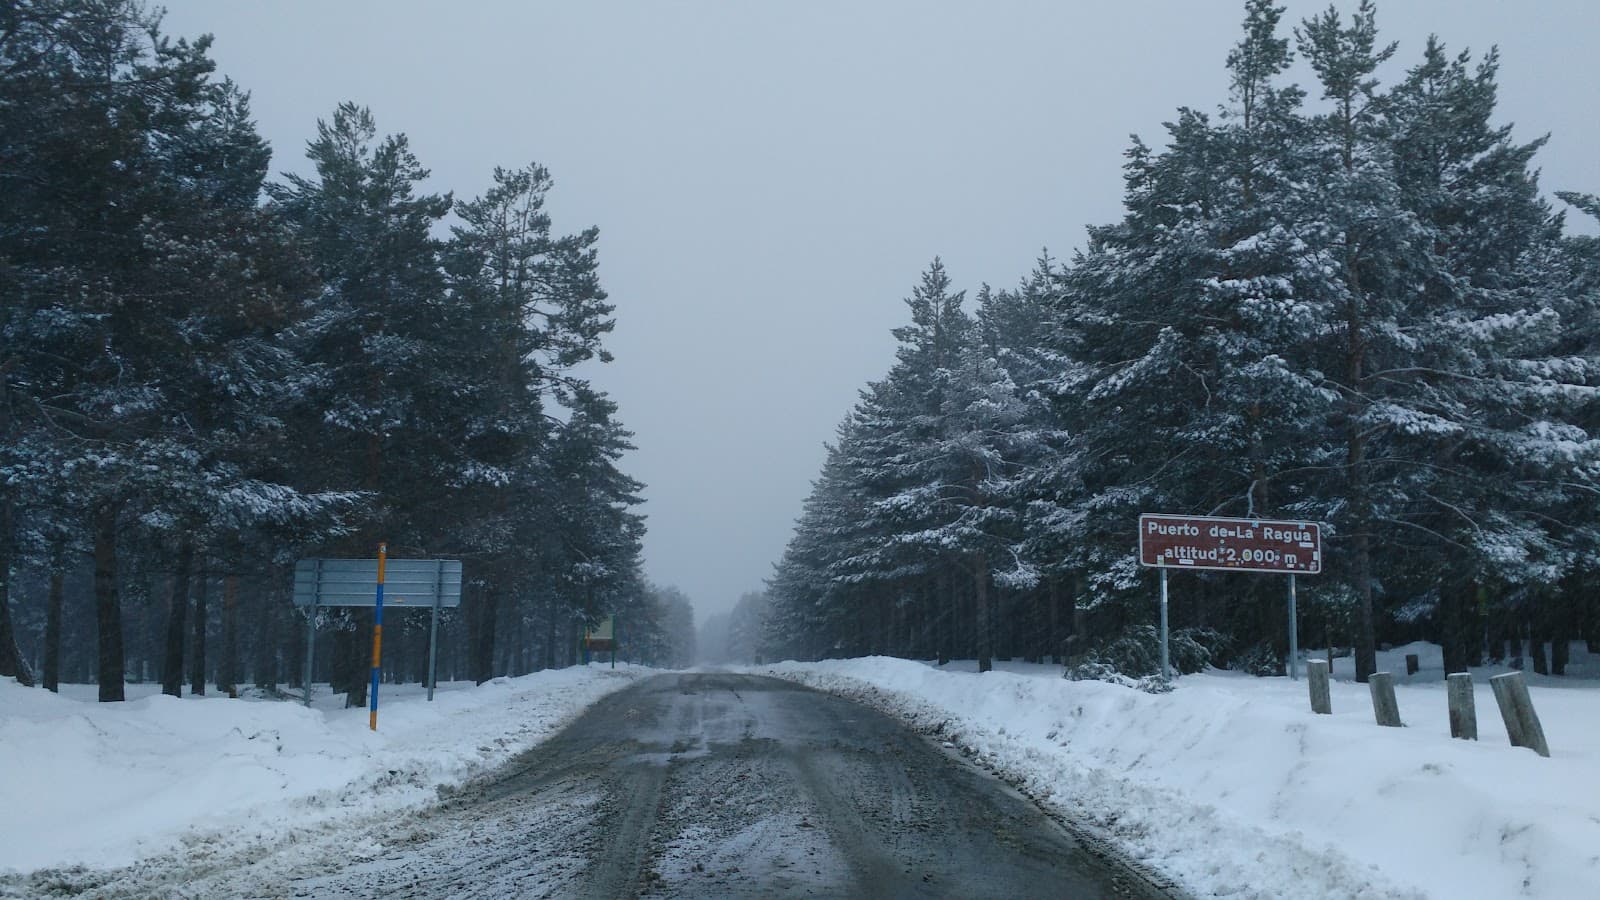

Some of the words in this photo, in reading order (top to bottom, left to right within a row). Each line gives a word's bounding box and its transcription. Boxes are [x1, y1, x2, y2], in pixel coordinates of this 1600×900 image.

[1148, 521, 1200, 536] Puerto
[1236, 526, 1254, 539] La
[1263, 527, 1312, 543] Ragua
[1164, 545, 1218, 561] altitud
[1226, 548, 1275, 562] 2.000
[1284, 553, 1298, 564] m
